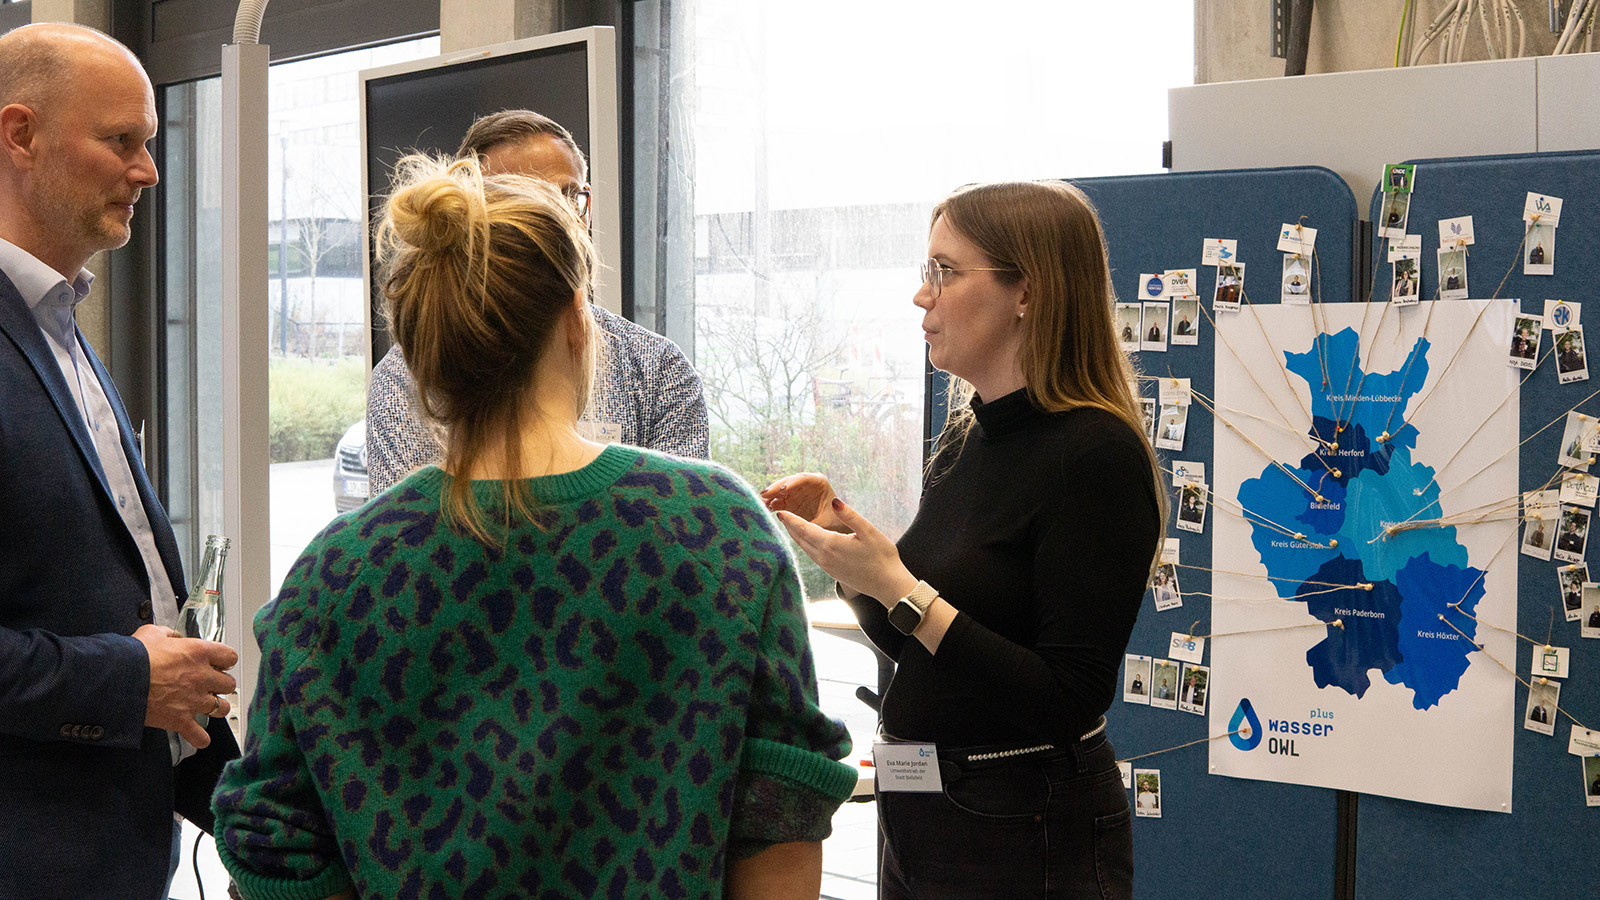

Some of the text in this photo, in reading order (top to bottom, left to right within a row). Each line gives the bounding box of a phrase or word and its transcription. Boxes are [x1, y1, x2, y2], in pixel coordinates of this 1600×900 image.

[1326, 394, 1344, 402] Kreis
[1338, 449, 1365, 457] Herford
[1271, 540, 1289, 548] Kreis
[1334, 607, 1385, 619] Kreis Paderborn
[1417, 630, 1460, 641] Kreis Höxter
[1310, 708, 1334, 719] plus
[1268, 719, 1333, 737] wasser
[1268, 737, 1300, 757] OWL
[910, 760, 929, 768] Jordan
